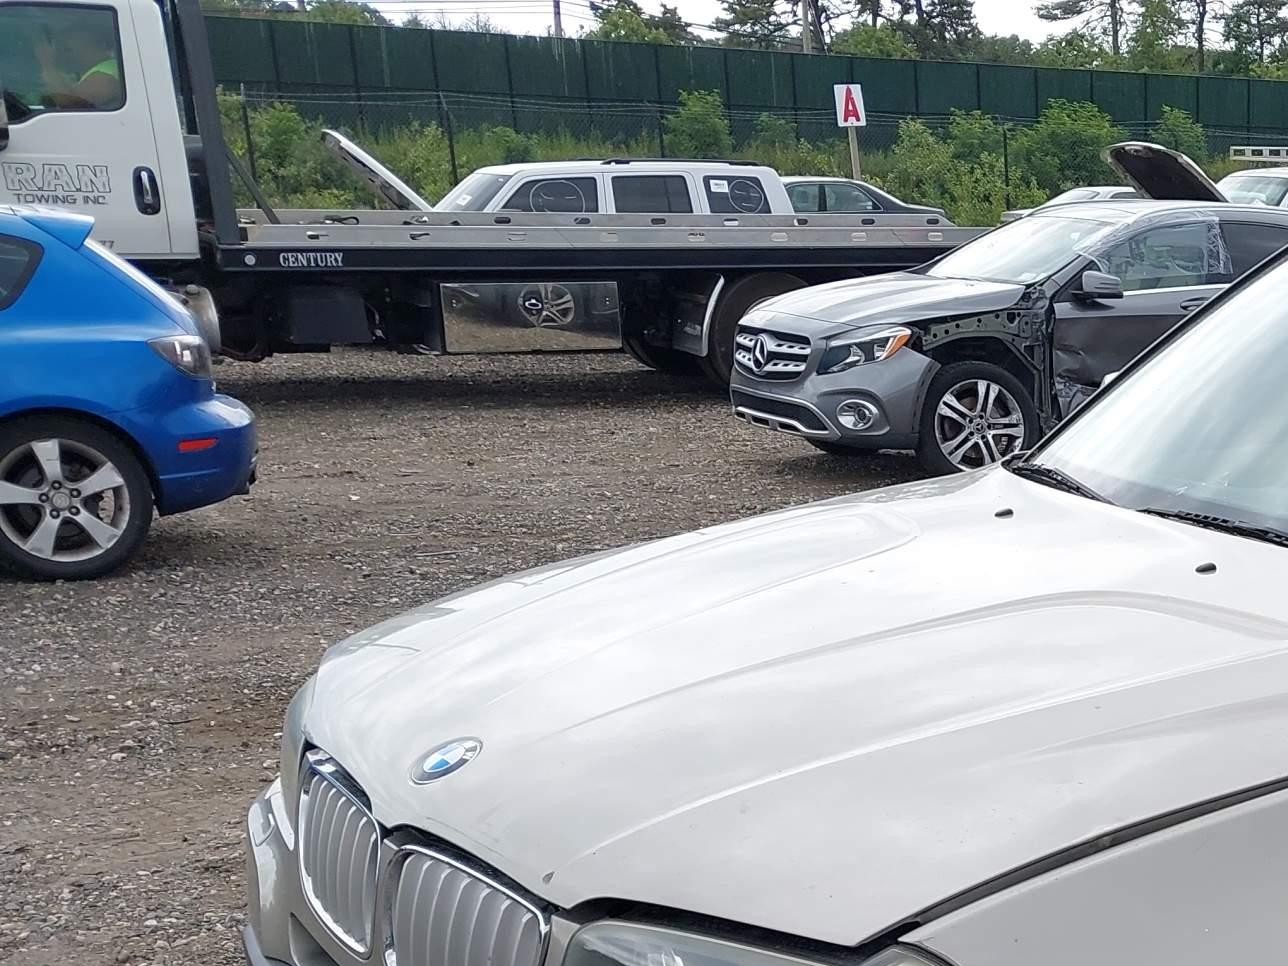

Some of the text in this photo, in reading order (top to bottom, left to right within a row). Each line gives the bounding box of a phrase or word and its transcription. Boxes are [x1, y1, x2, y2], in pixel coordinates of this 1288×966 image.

[843, 85, 861, 122] A
[1, 162, 111, 193] RAN
[13, 193, 108, 205] TOWING INC
[279, 252, 344, 267] CENTURY
